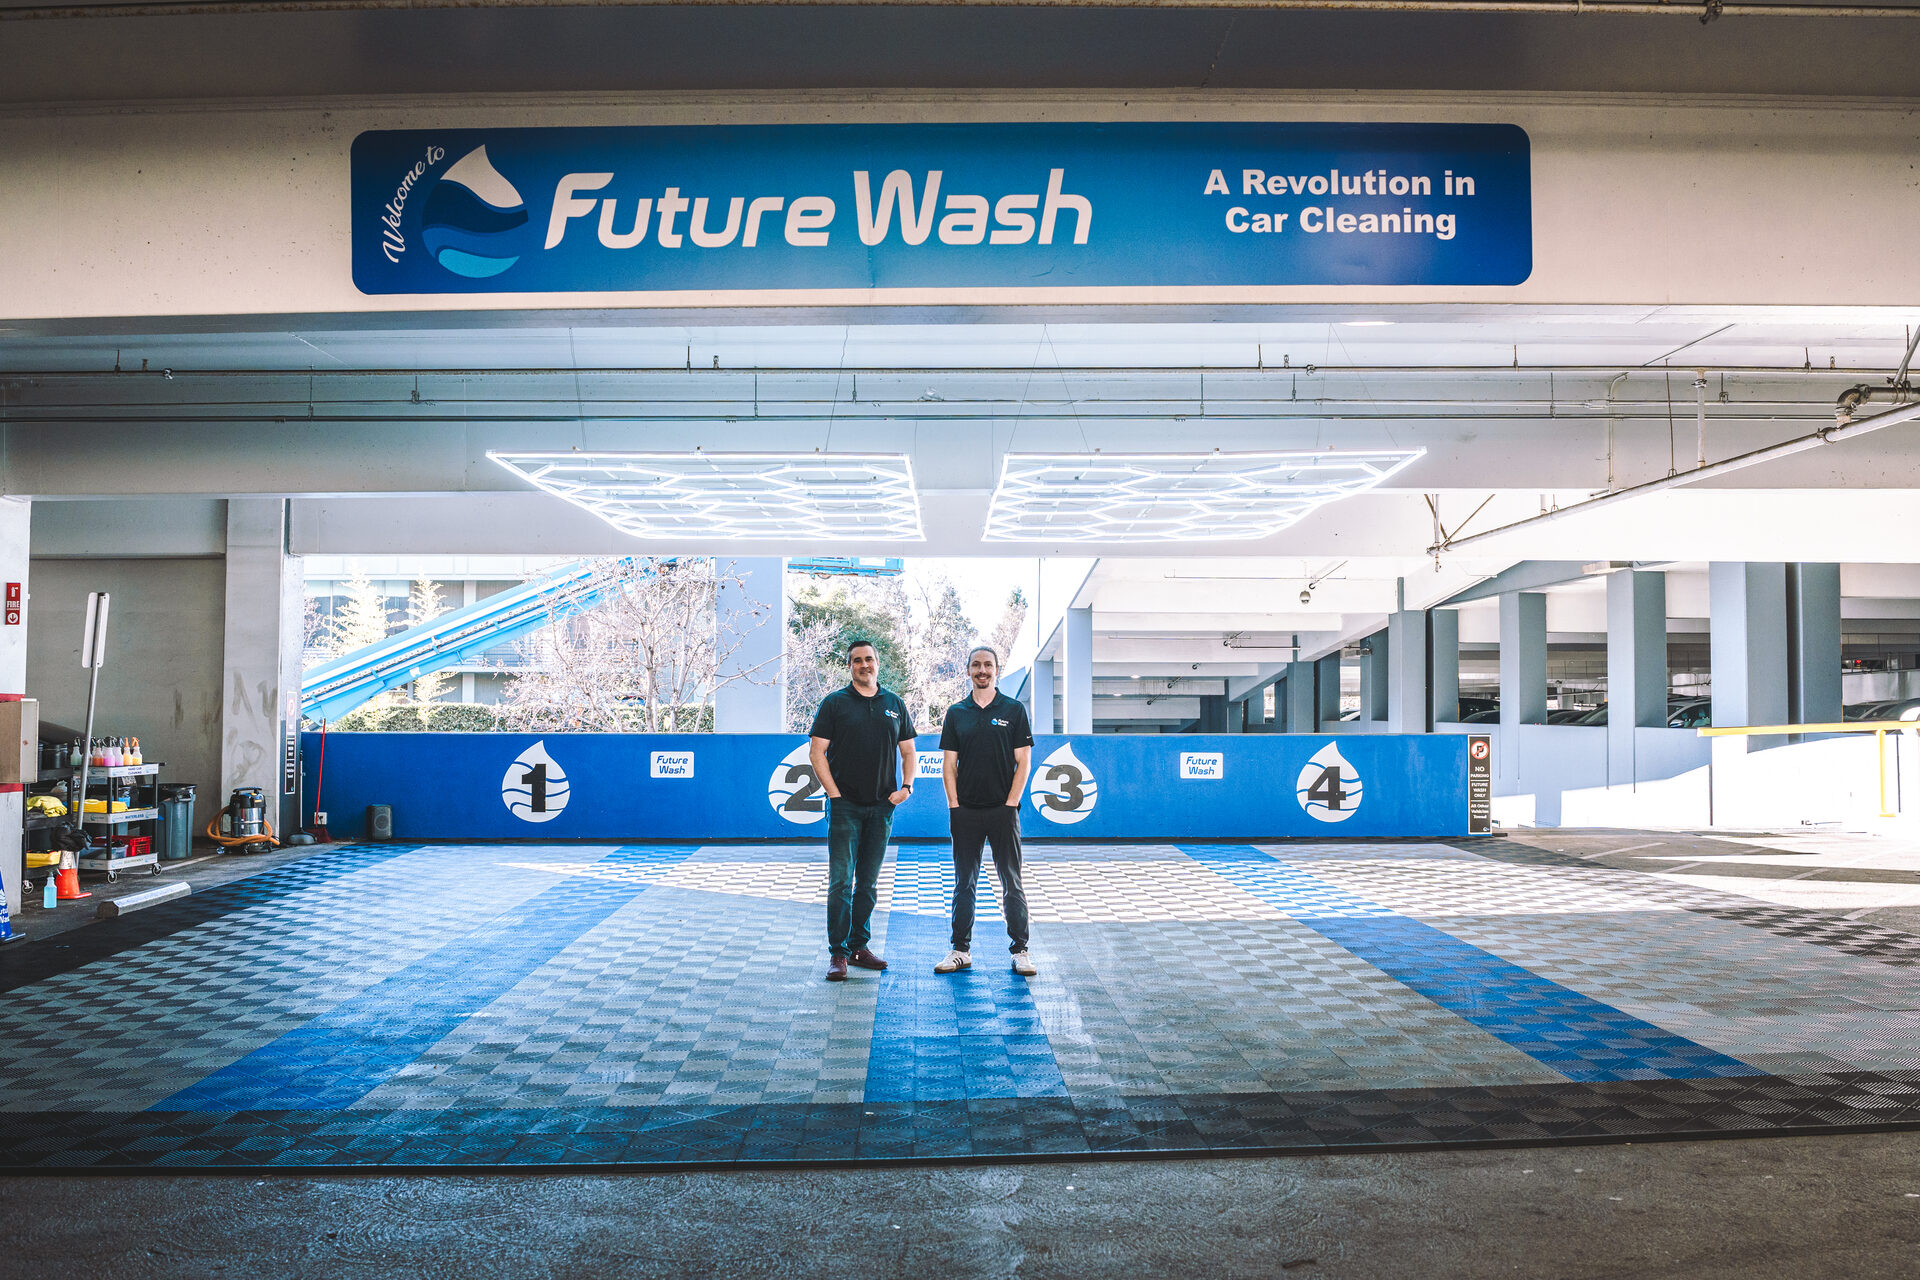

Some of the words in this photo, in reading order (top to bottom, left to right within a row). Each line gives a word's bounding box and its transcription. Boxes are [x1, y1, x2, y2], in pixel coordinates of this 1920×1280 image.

[1203, 169, 1230, 195] A
[1242, 169, 1431, 196] Revolution
[1444, 170, 1475, 196] in
[382, 160, 426, 264] Welcome
[425, 145, 445, 165] to
[544, 172, 836, 249] Future
[853, 168, 1093, 246] Wash
[1225, 206, 1288, 233] Car
[1299, 206, 1456, 240] Cleaning
[656, 755, 689, 765] Future
[659, 765, 686, 775] Wash
[918, 755, 944, 764] Futur
[921, 765, 943, 774] Was
[1185, 756, 1218, 766] Future
[1188, 766, 1215, 776] Wash
[521, 763, 547, 813] 1
[784, 764, 823, 812] 2
[1044, 764, 1083, 812] 3
[1307, 766, 1347, 811] 4
